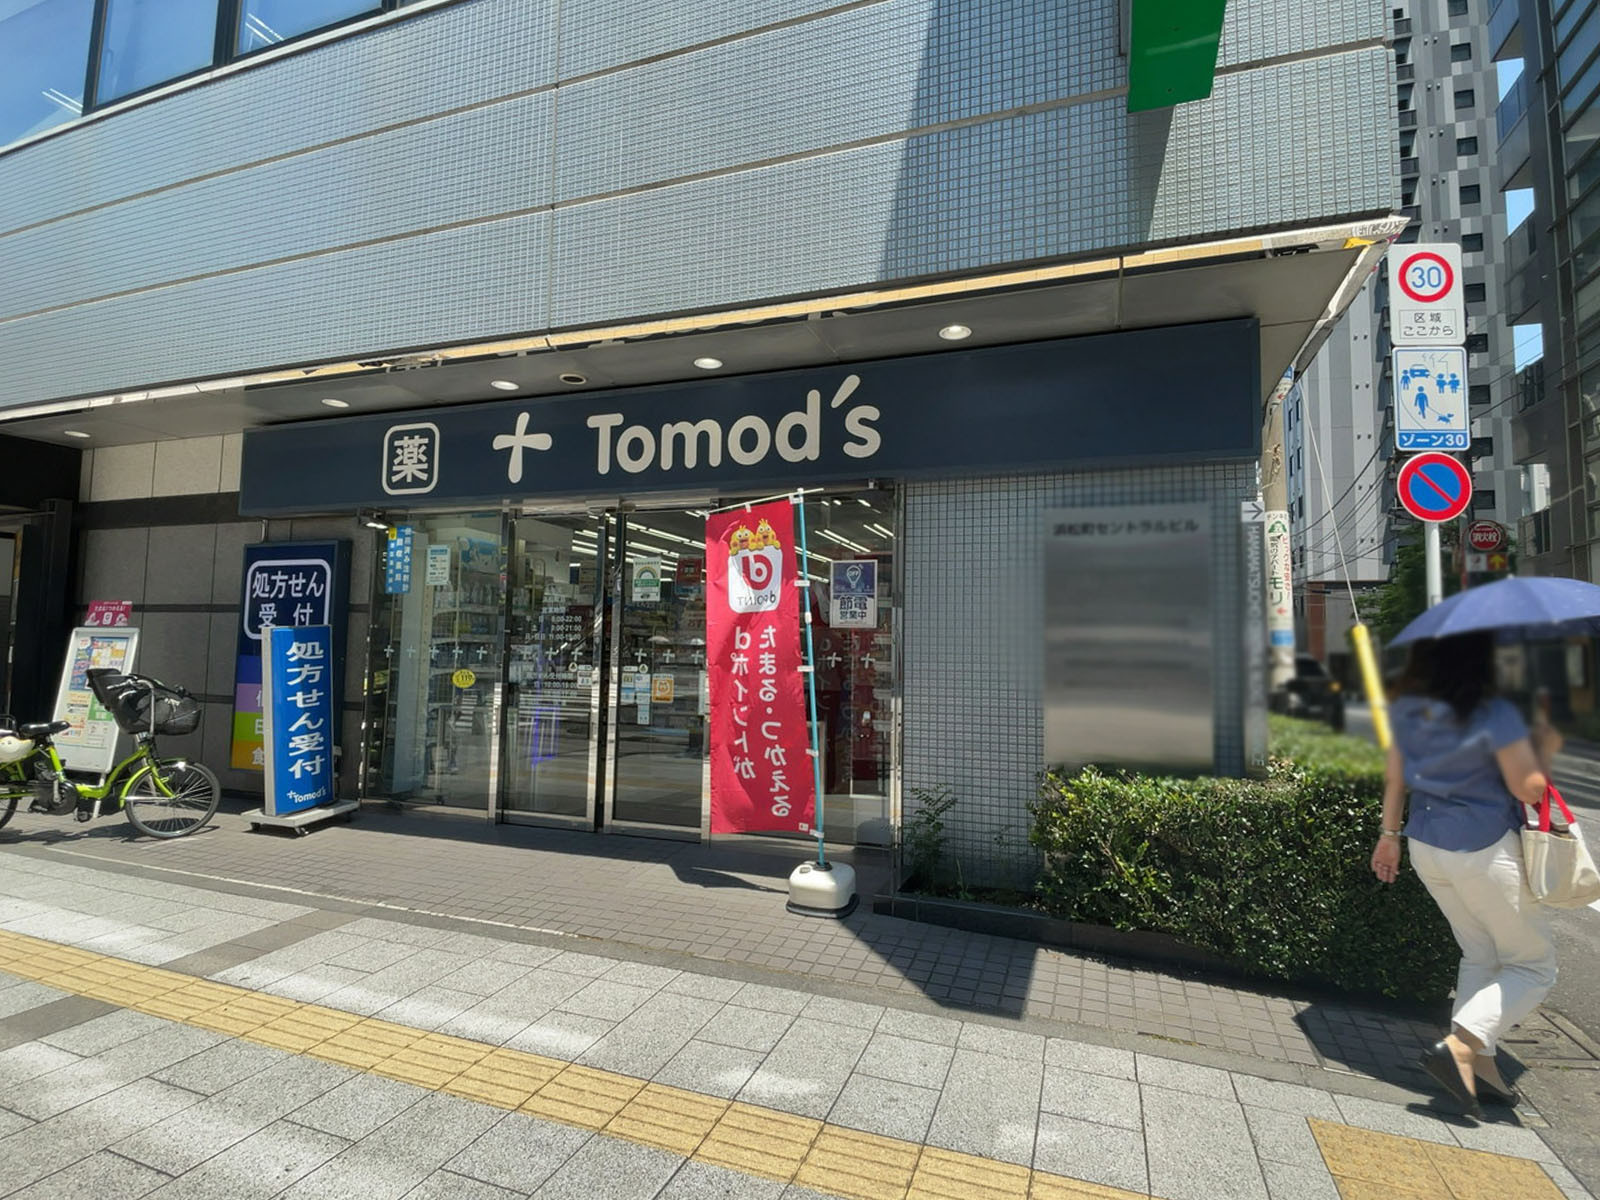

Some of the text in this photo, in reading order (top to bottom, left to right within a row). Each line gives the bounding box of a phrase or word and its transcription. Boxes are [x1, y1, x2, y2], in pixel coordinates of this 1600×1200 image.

[1411, 266, 1442, 288] 30
[1413, 312, 1442, 323] 区域
[1403, 325, 1454, 336] ここから
[586, 374, 882, 475] Tomod's
[1401, 434, 1465, 447] ゾーン30
[392, 435, 428, 483] 薬
[252, 570, 324, 599] 処方せん
[286, 641, 325, 779] 処方せん受付
